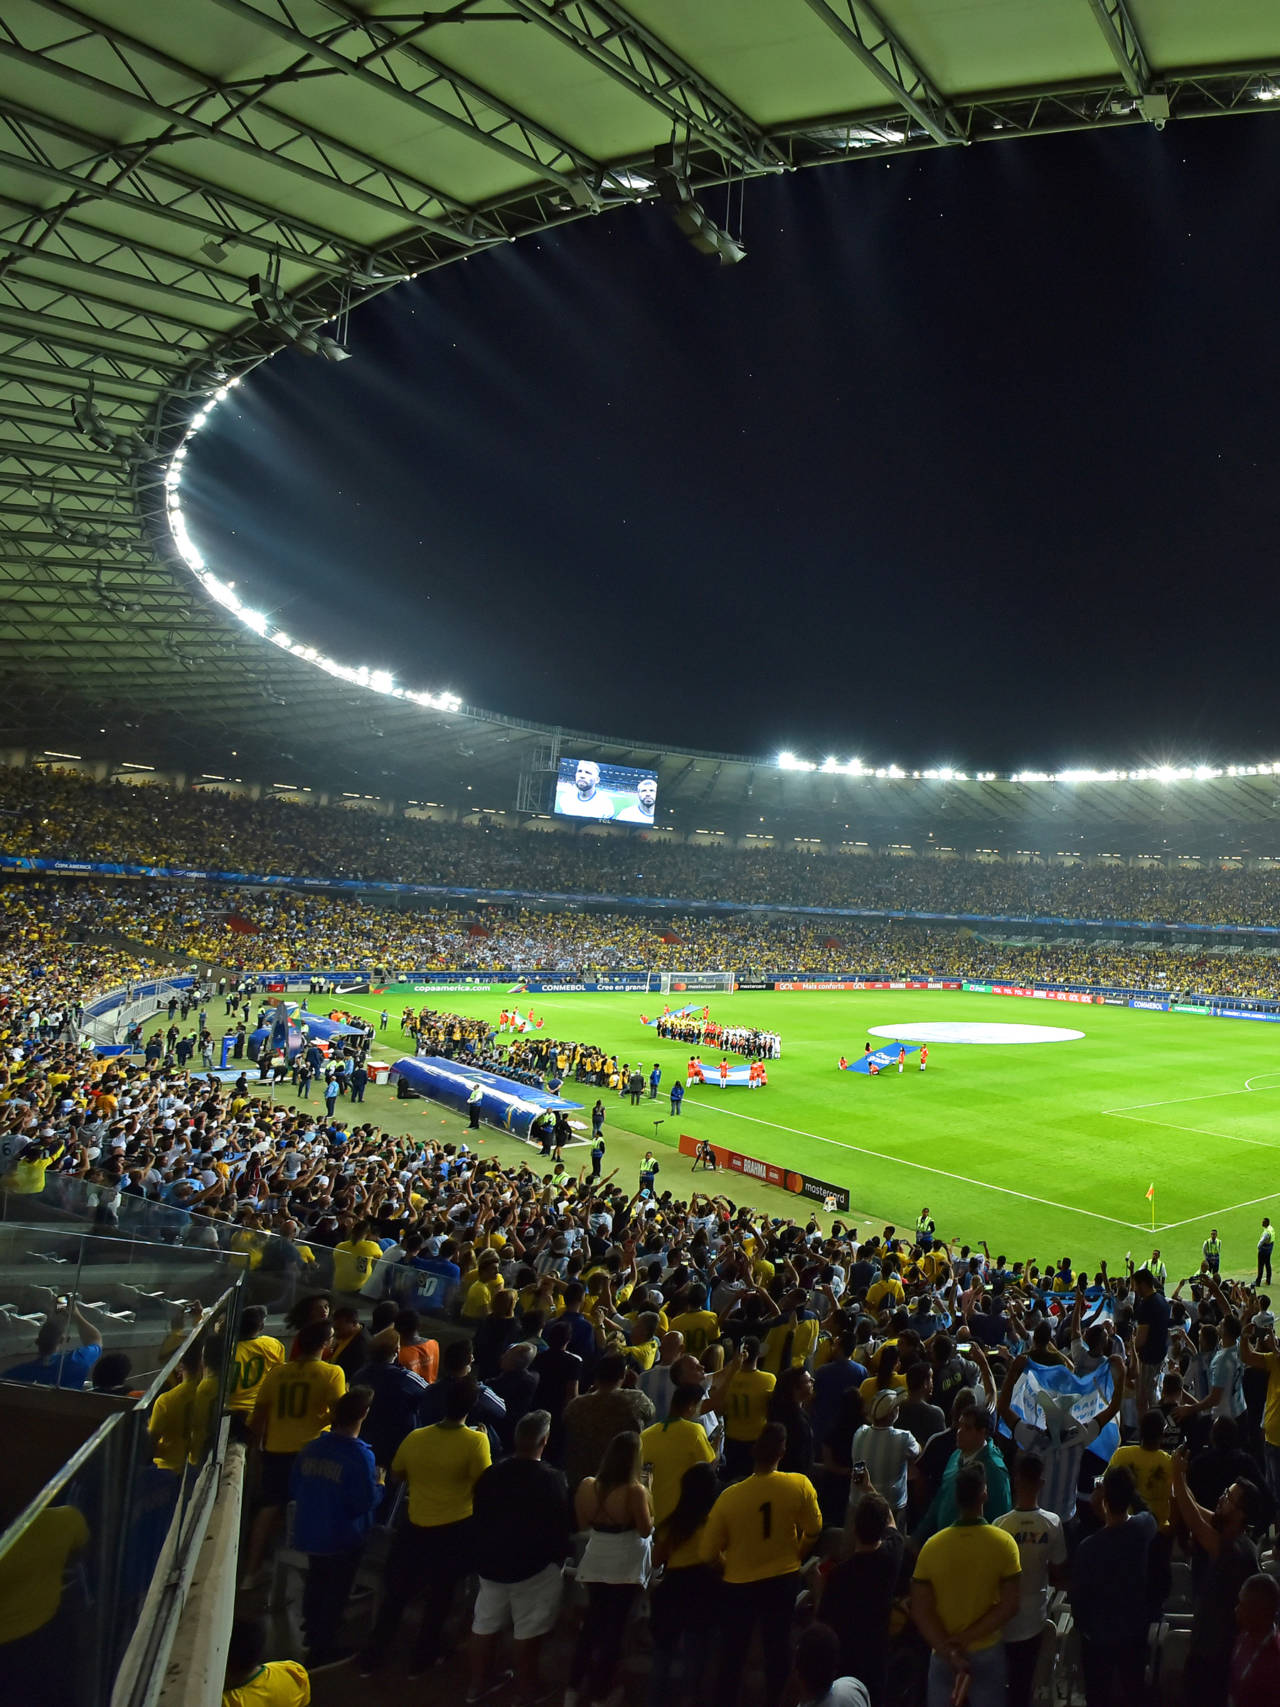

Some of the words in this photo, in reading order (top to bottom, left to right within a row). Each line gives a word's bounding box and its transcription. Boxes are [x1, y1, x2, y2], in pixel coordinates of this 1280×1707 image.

[414, 984, 490, 992] copaamerica.com
[853, 982, 866, 990] GOL
[1134, 1001, 1163, 1010] CONMEBOL
[743, 1159, 766, 1179] BRAHMA
[805, 1182, 845, 1205] mastercard
[278, 1382, 310, 1420] 10
[758, 1501, 772, 1539] 1
